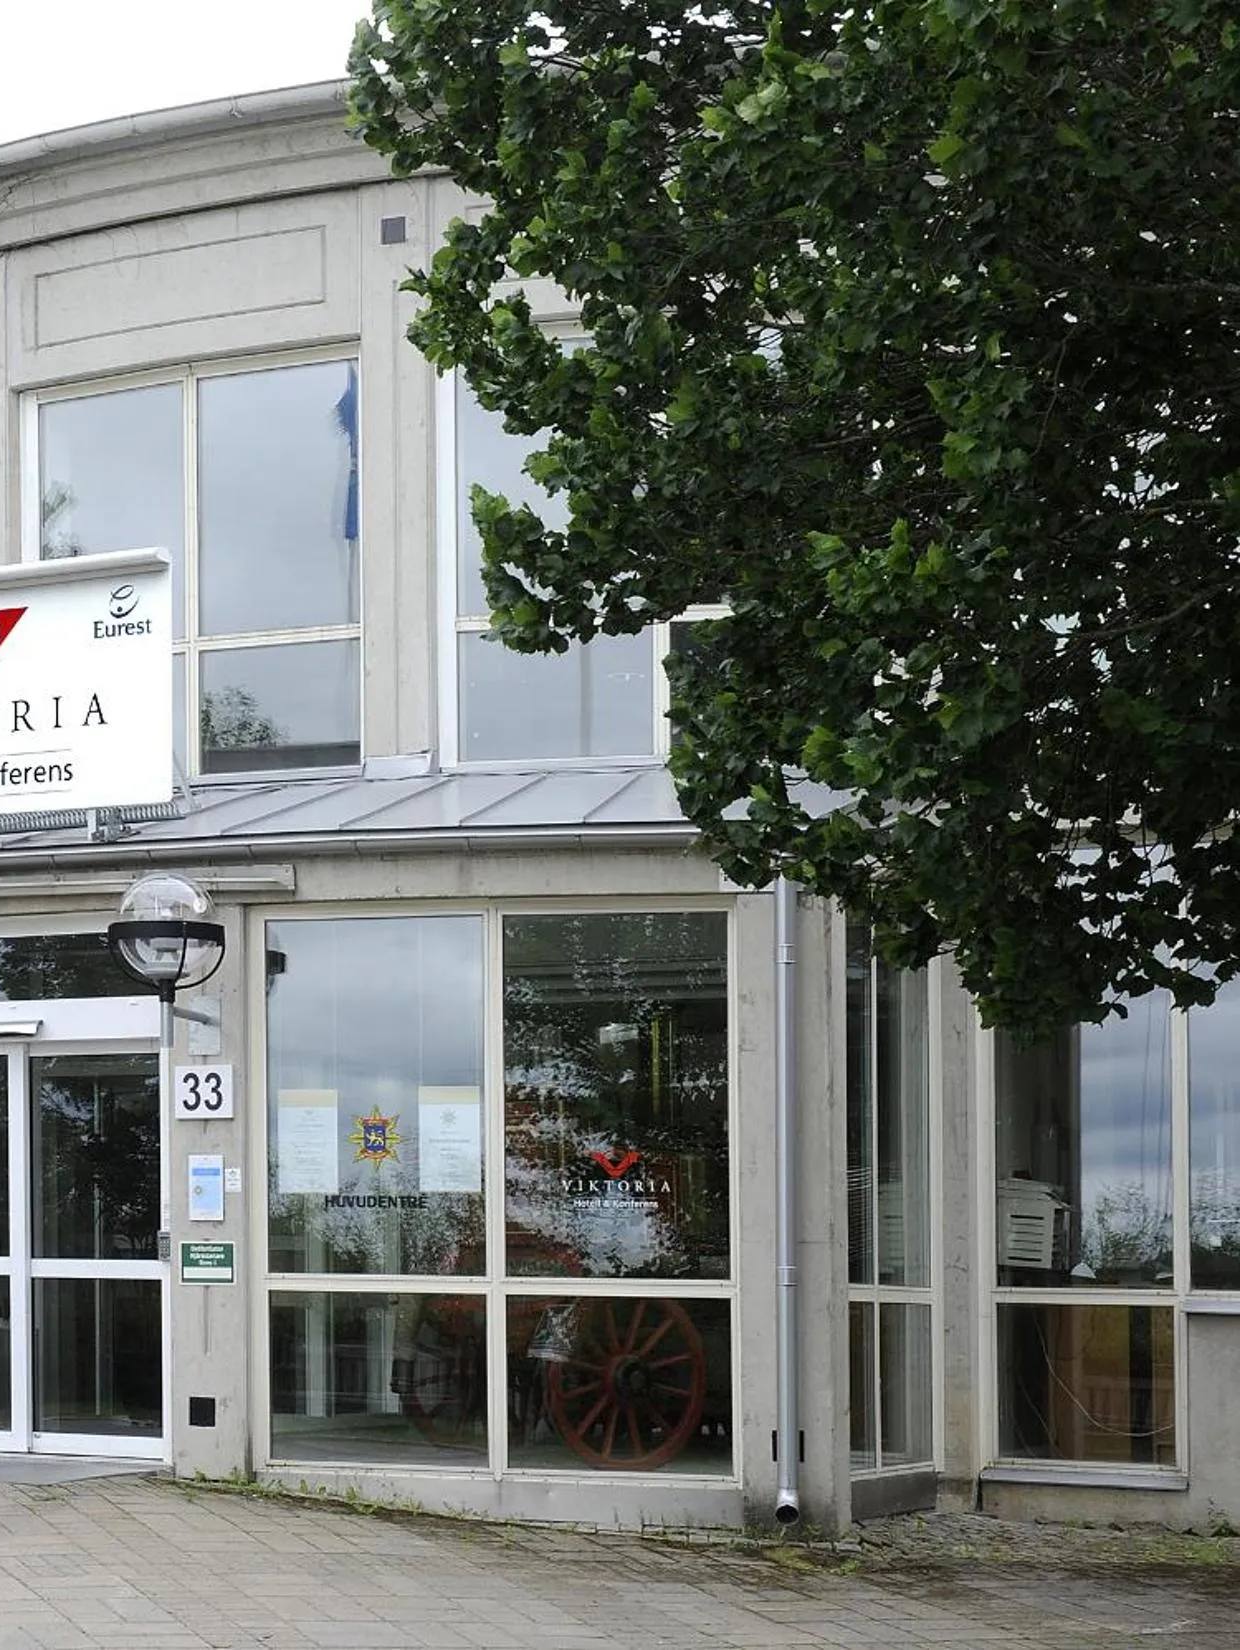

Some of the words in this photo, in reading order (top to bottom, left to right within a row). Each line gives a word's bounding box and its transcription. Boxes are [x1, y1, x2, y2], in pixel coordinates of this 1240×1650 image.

[93, 618, 152, 639] Eurest
[182, 1072, 223, 1112] 33
[561, 1180, 671, 1192] VIKTORIA
